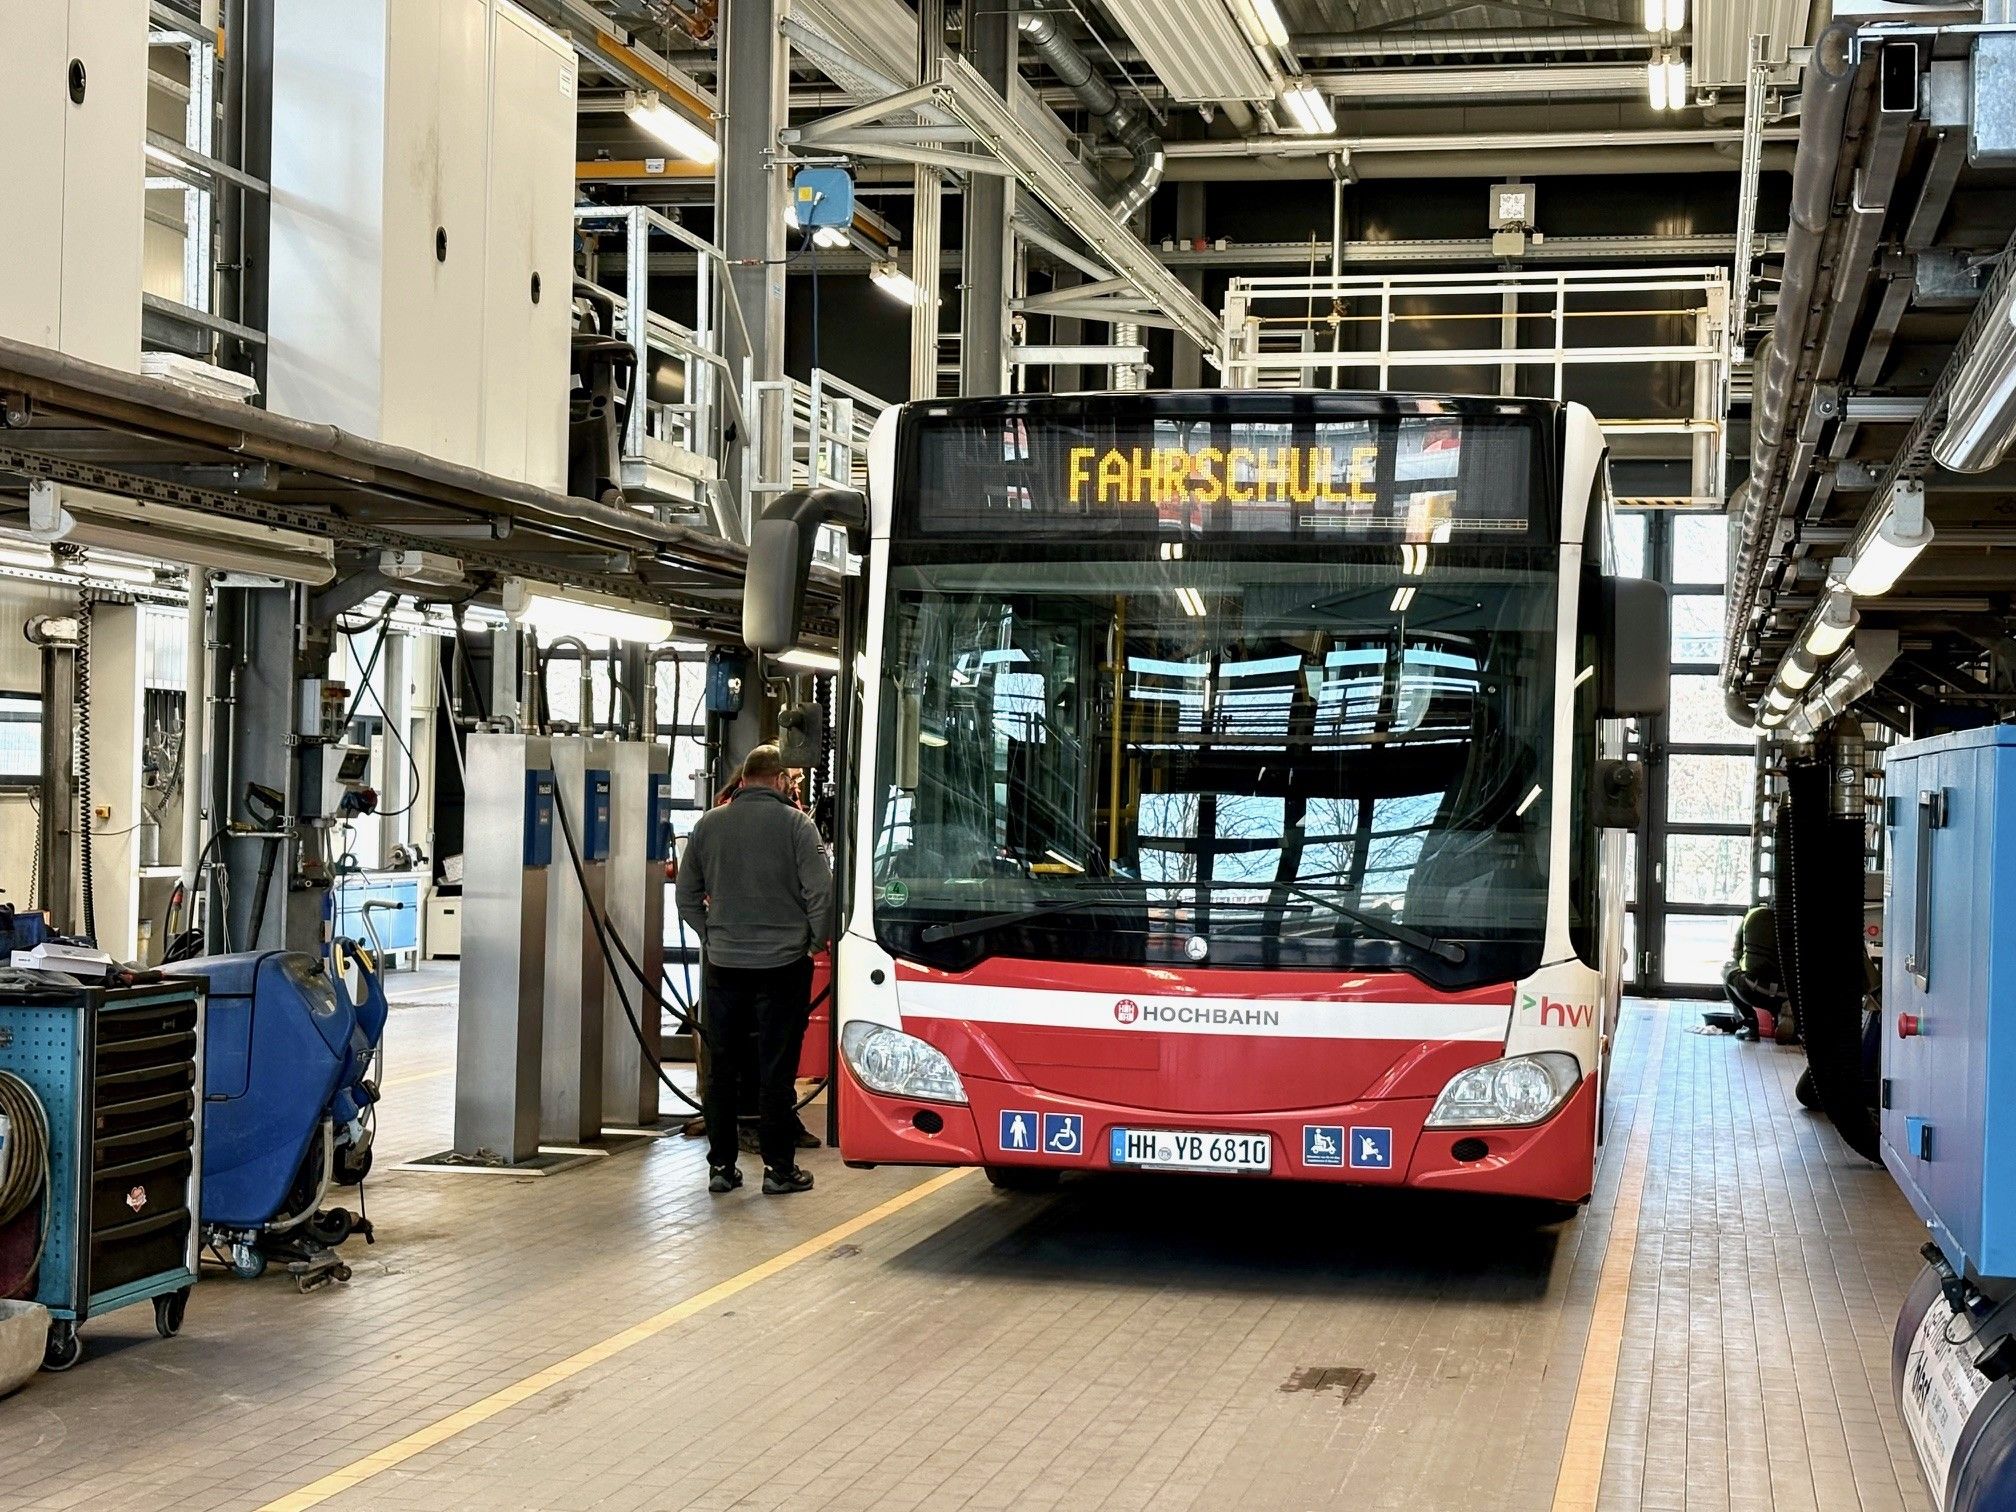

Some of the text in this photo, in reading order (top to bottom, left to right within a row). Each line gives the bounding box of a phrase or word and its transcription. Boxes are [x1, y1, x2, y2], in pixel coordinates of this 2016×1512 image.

[1070, 447, 1378, 502] FAHRSCHULE
[1143, 1005, 1279, 1026] HOCHBAHN
[1541, 996, 1594, 1028] hvv
[1115, 1148, 1122, 1156] D
[1128, 1134, 1266, 1164] HH YB 6810
